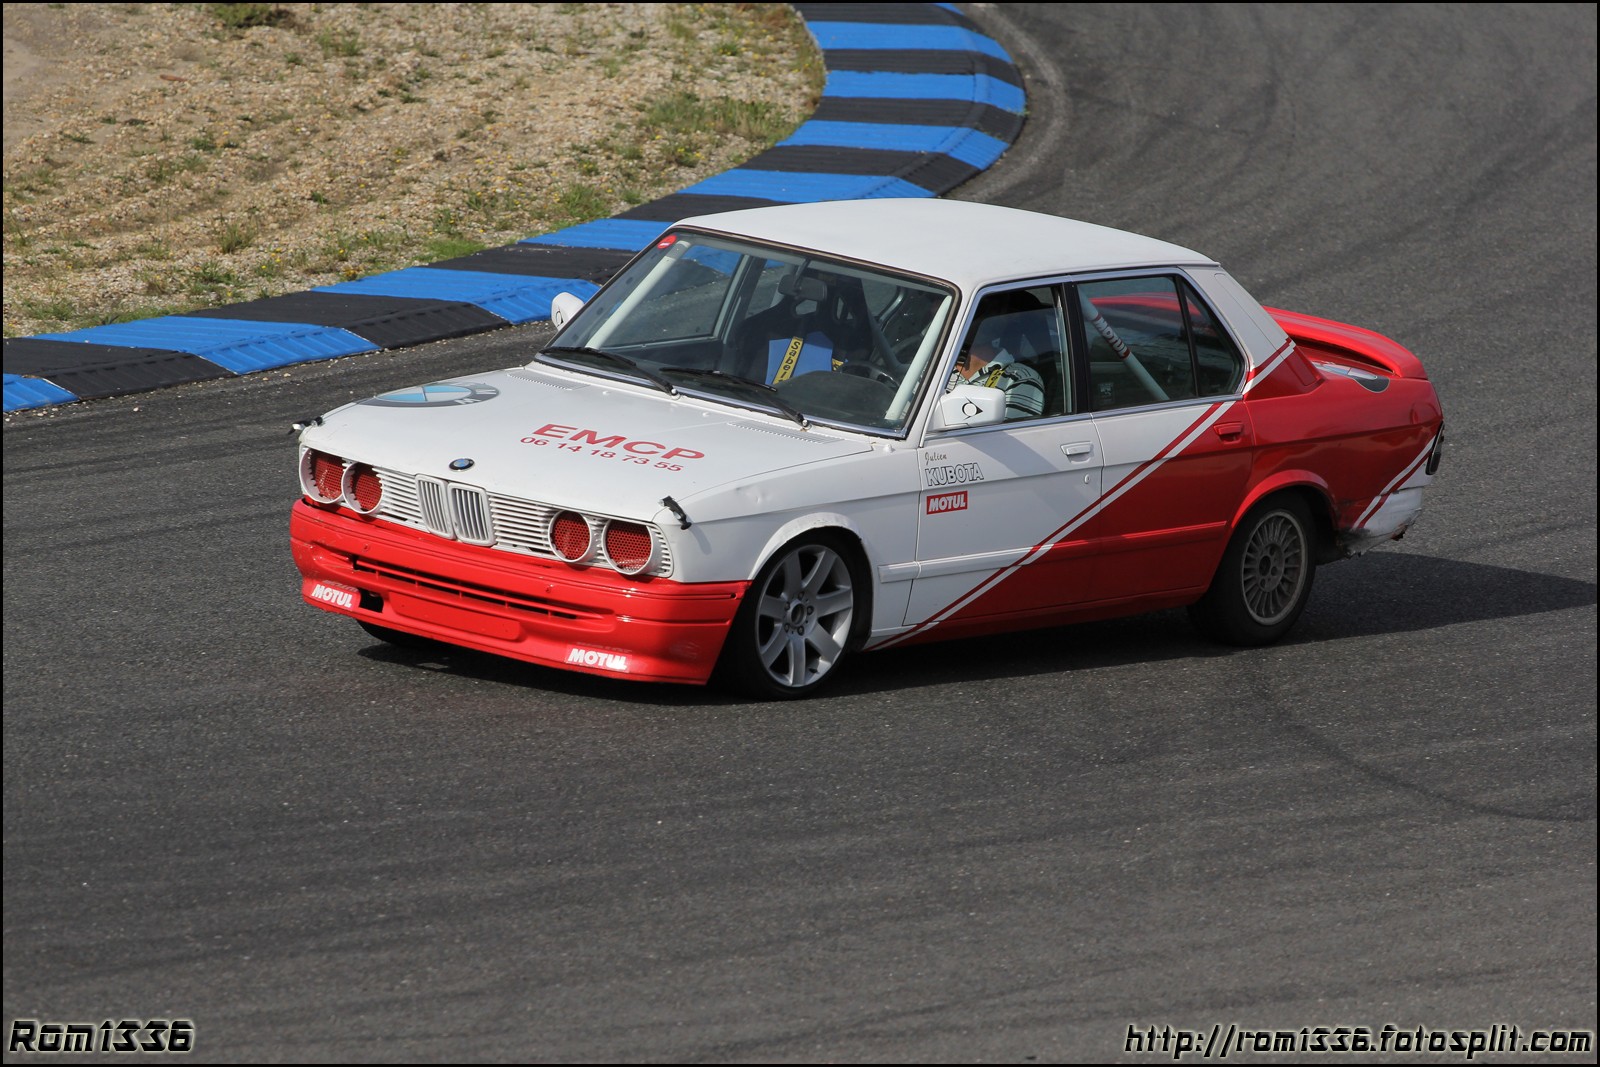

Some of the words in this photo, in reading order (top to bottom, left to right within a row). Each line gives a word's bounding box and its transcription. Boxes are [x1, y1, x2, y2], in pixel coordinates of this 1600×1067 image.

[778, 341, 801, 381] Sabel
[532, 423, 705, 460] EMCP
[520, 436, 550, 446] 06
[557, 442, 582, 453] 14
[590, 449, 616, 459] 18
[622, 454, 650, 465] 73
[654, 461, 684, 472] 55
[924, 452, 947, 465] Julien
[925, 462, 984, 486] KUBOTA
[928, 494, 966, 512] MOTUL
[311, 584, 353, 608] MOTUL
[568, 648, 628, 670] MOTUL
